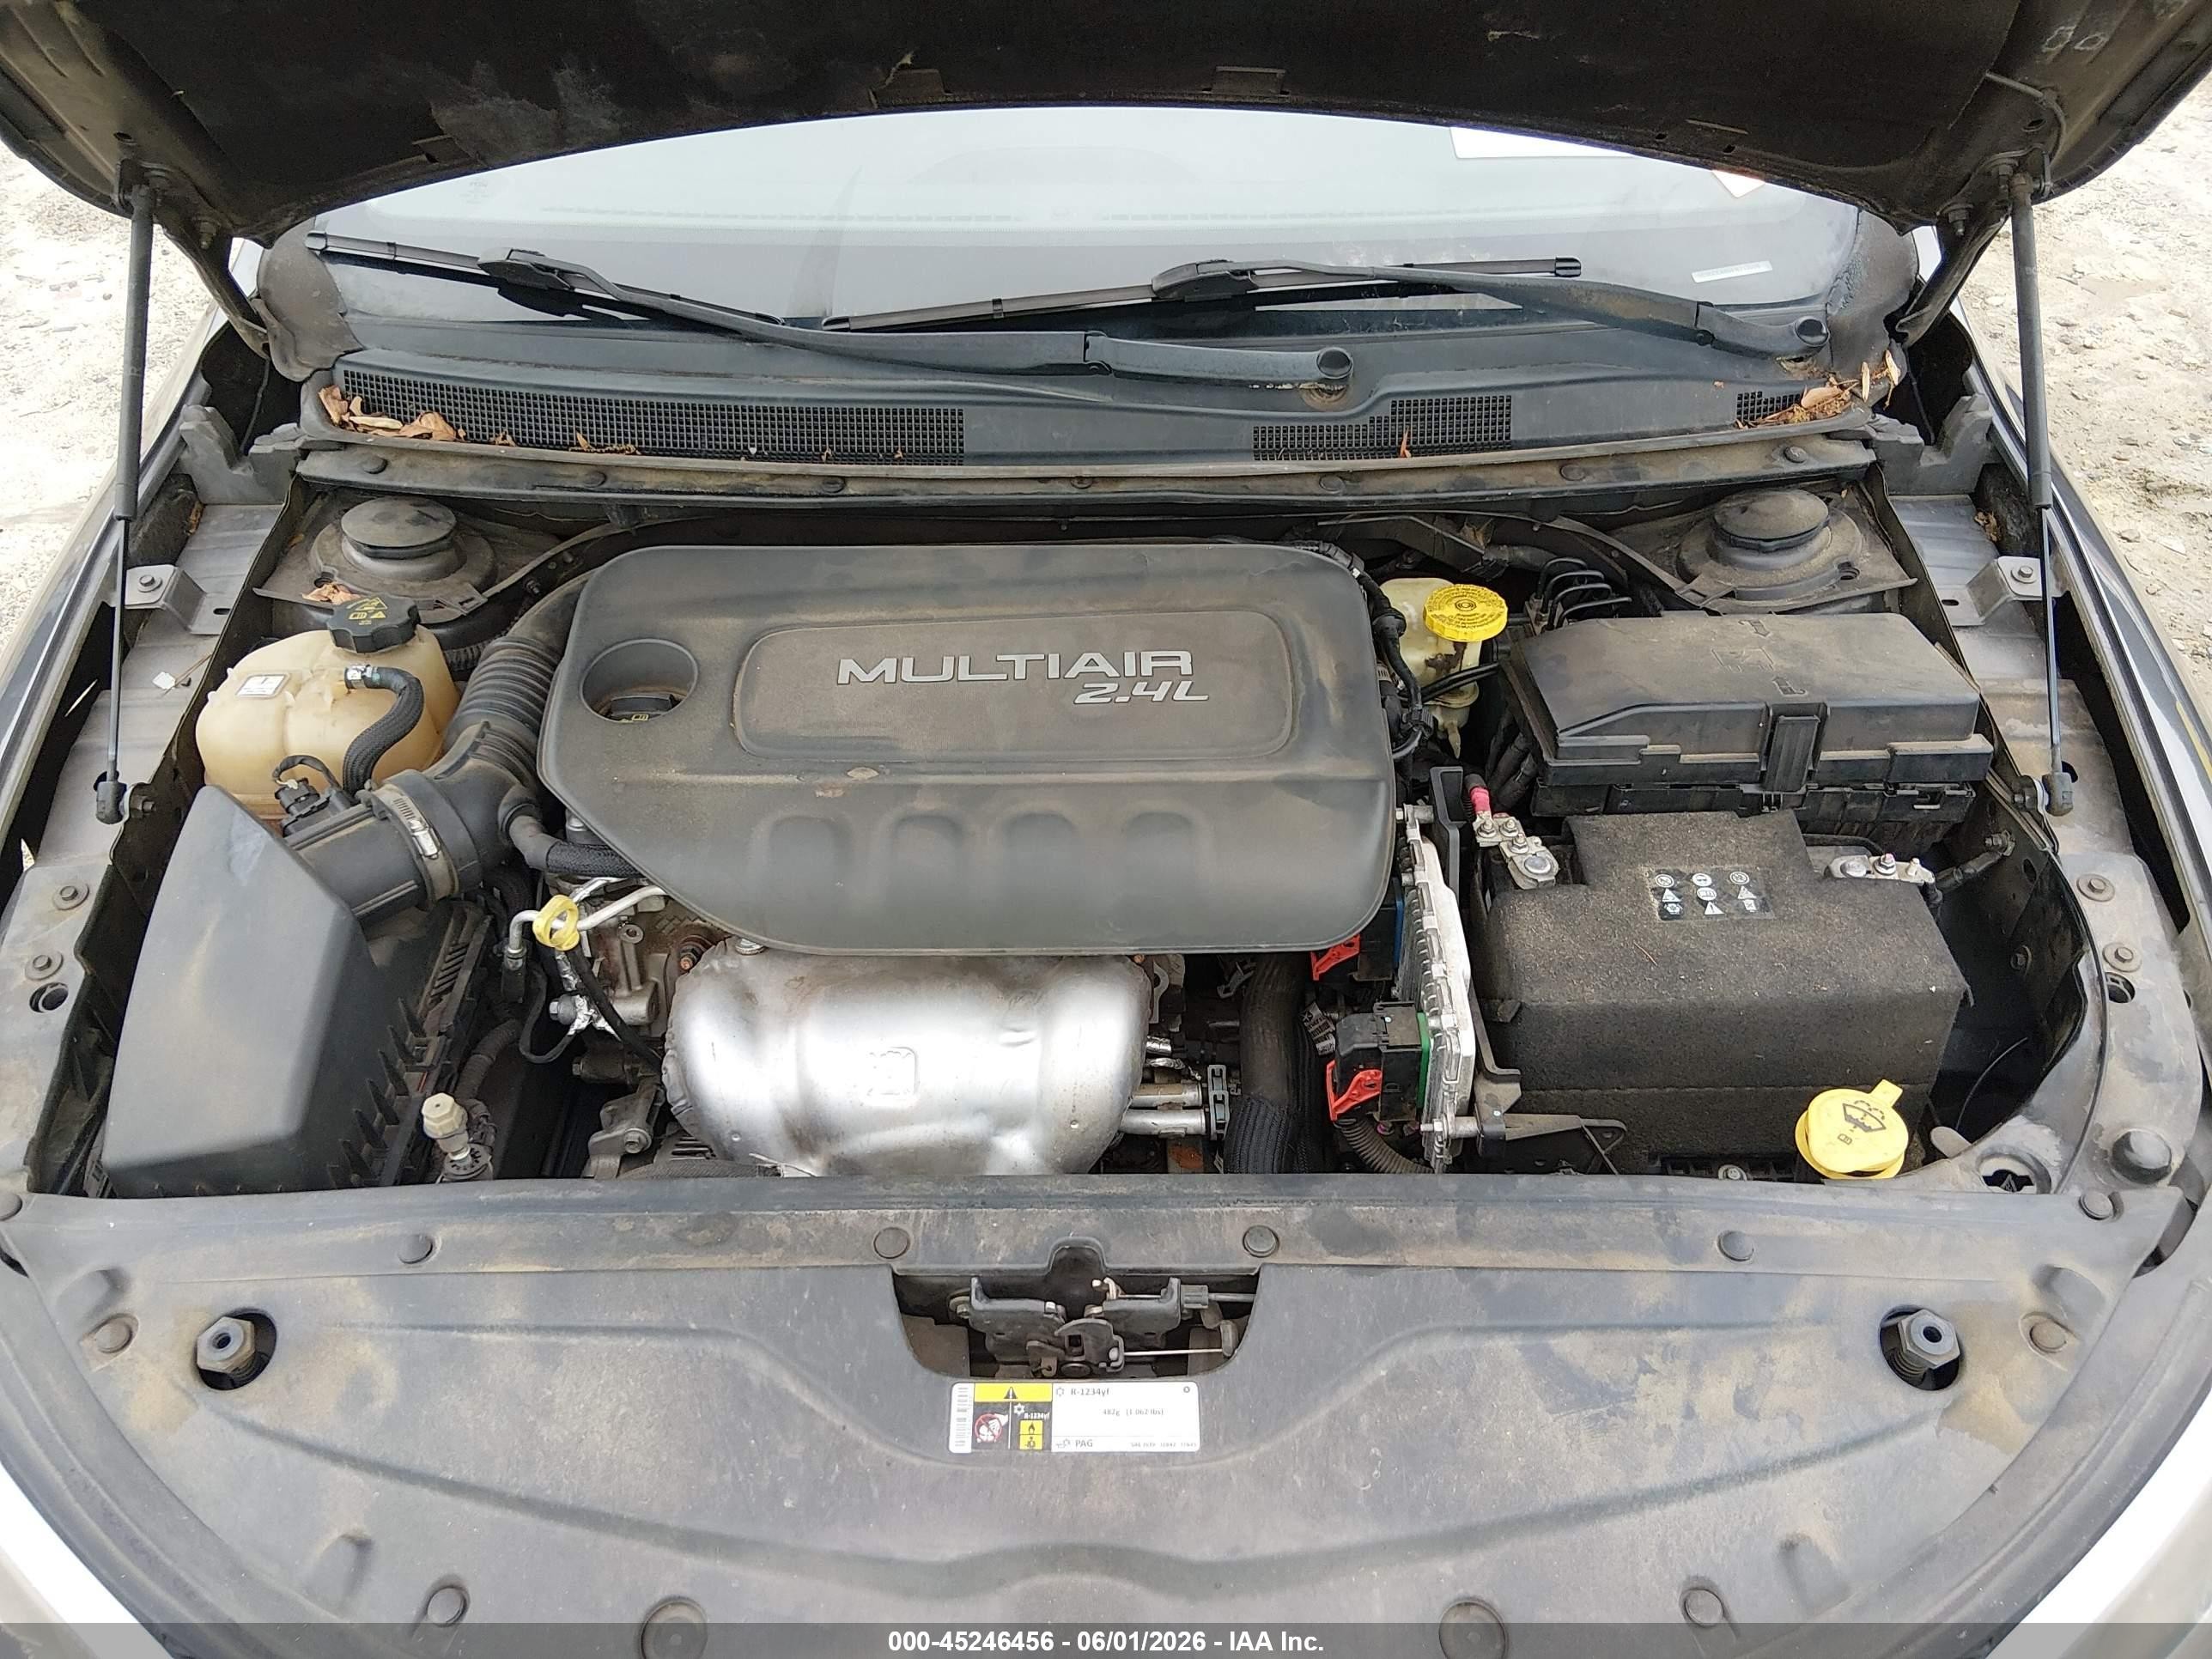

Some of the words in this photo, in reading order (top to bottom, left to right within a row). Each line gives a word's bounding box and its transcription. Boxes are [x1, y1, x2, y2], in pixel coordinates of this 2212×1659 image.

[837, 649, 1194, 685] MULTIAIR
[1073, 680, 1210, 704] 2.4L
[1070, 1388, 1109, 1397] R-1234yf
[1075, 1439, 1093, 1448] PAG
